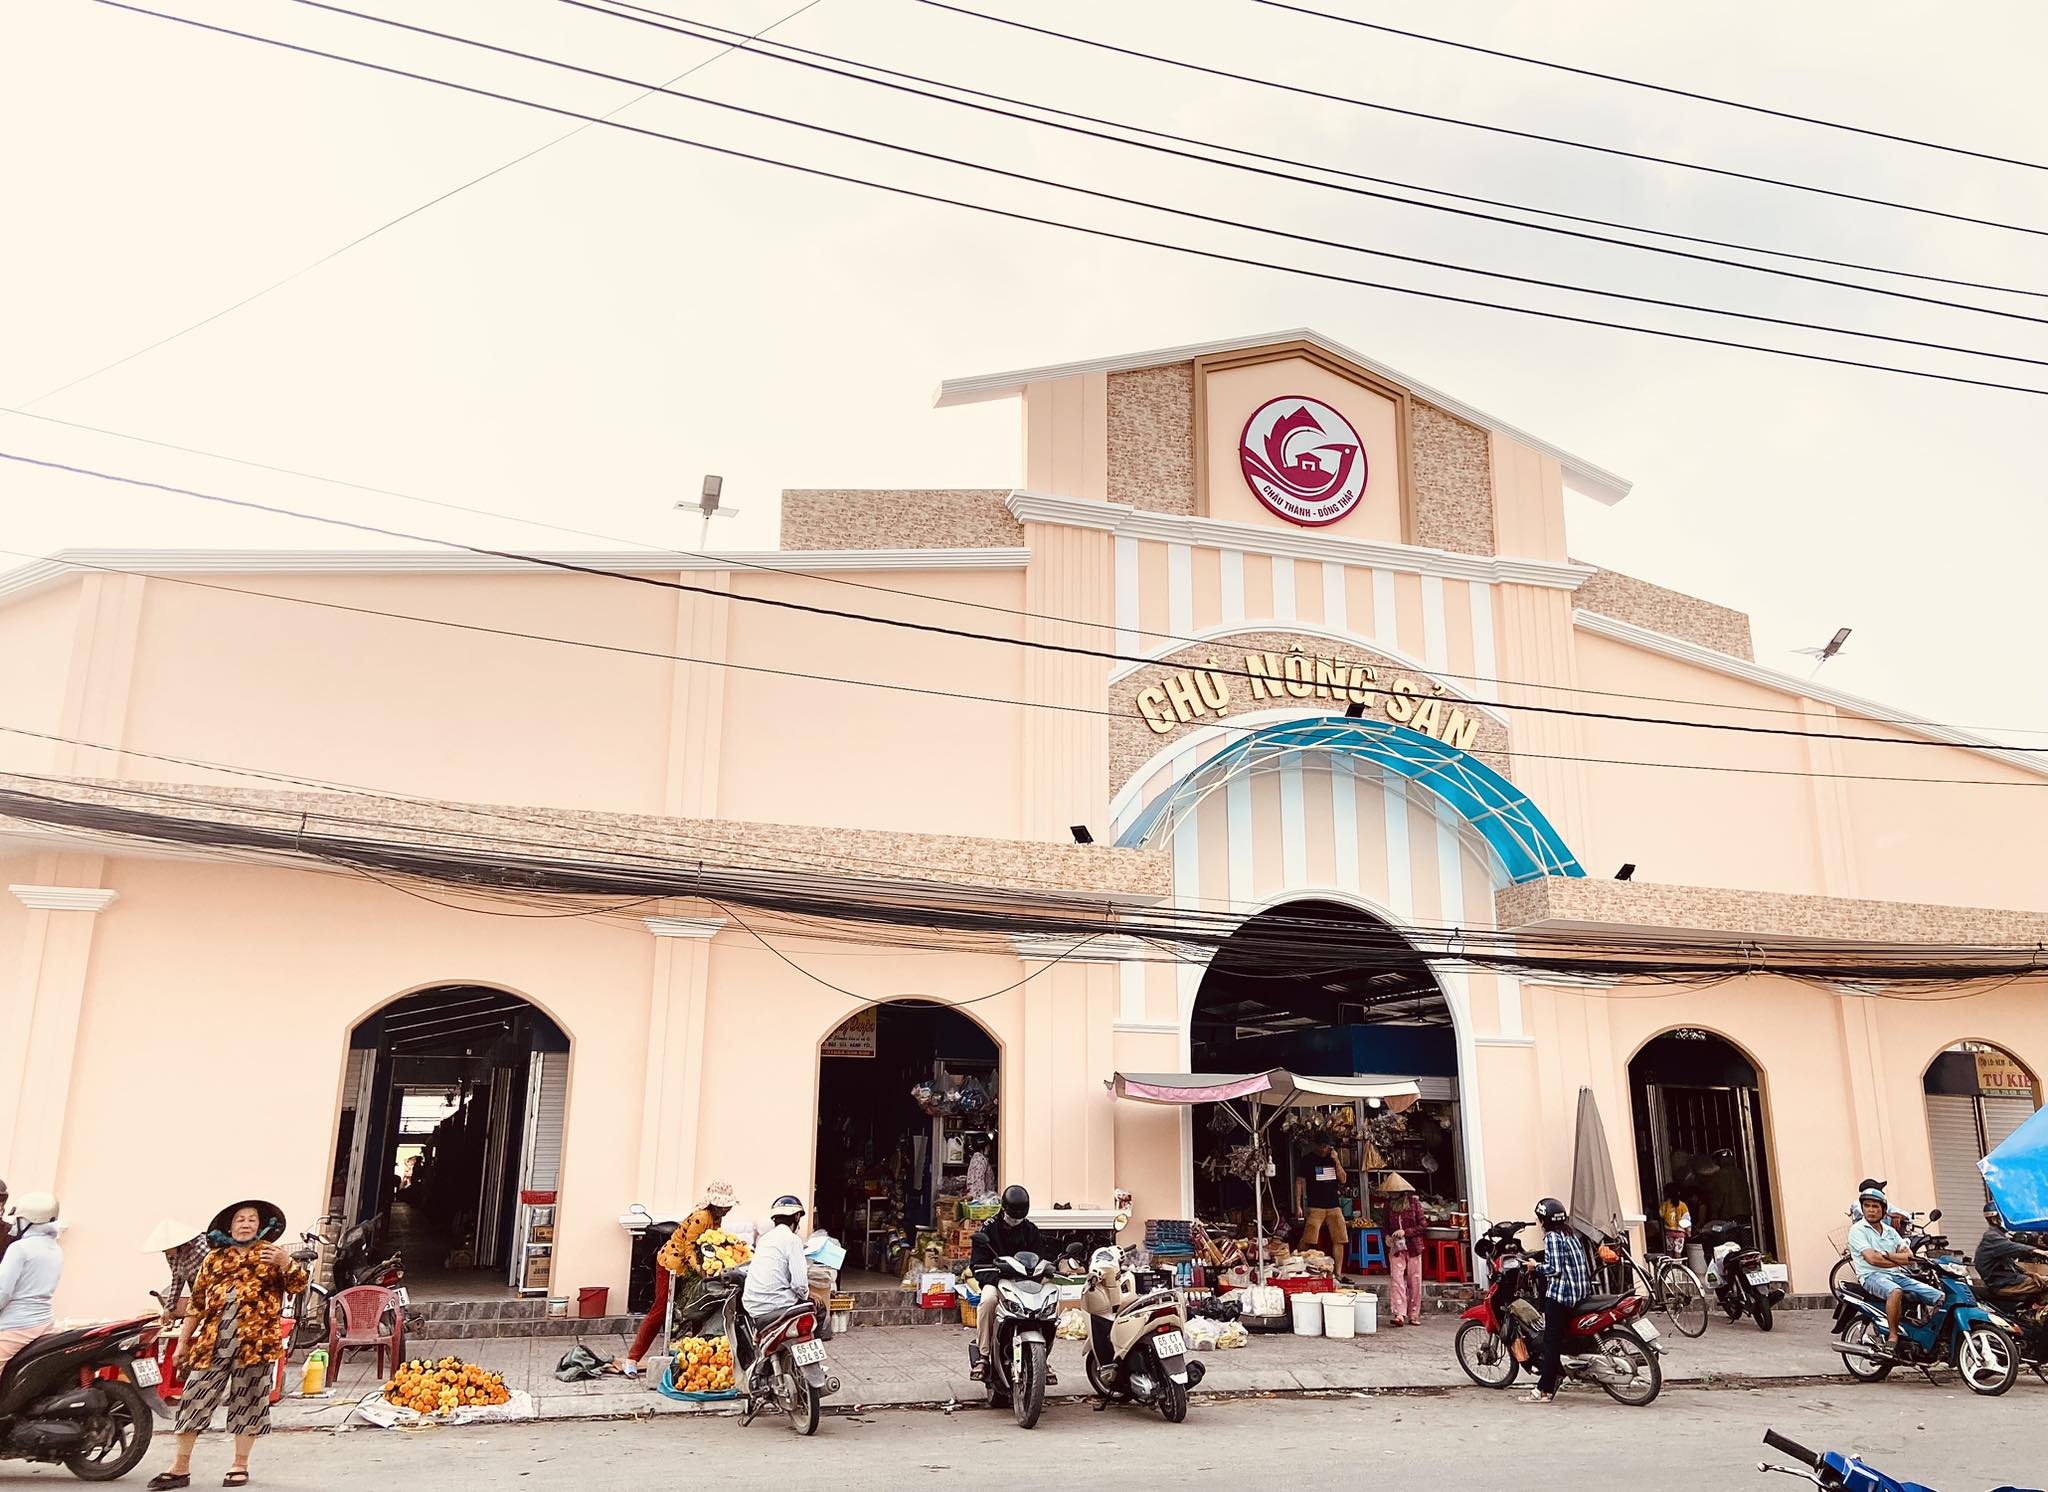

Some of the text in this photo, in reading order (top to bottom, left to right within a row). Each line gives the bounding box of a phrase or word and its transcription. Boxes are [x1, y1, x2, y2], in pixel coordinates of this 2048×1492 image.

[1136, 643, 1480, 750] CHỢ NÔNG SẢN
